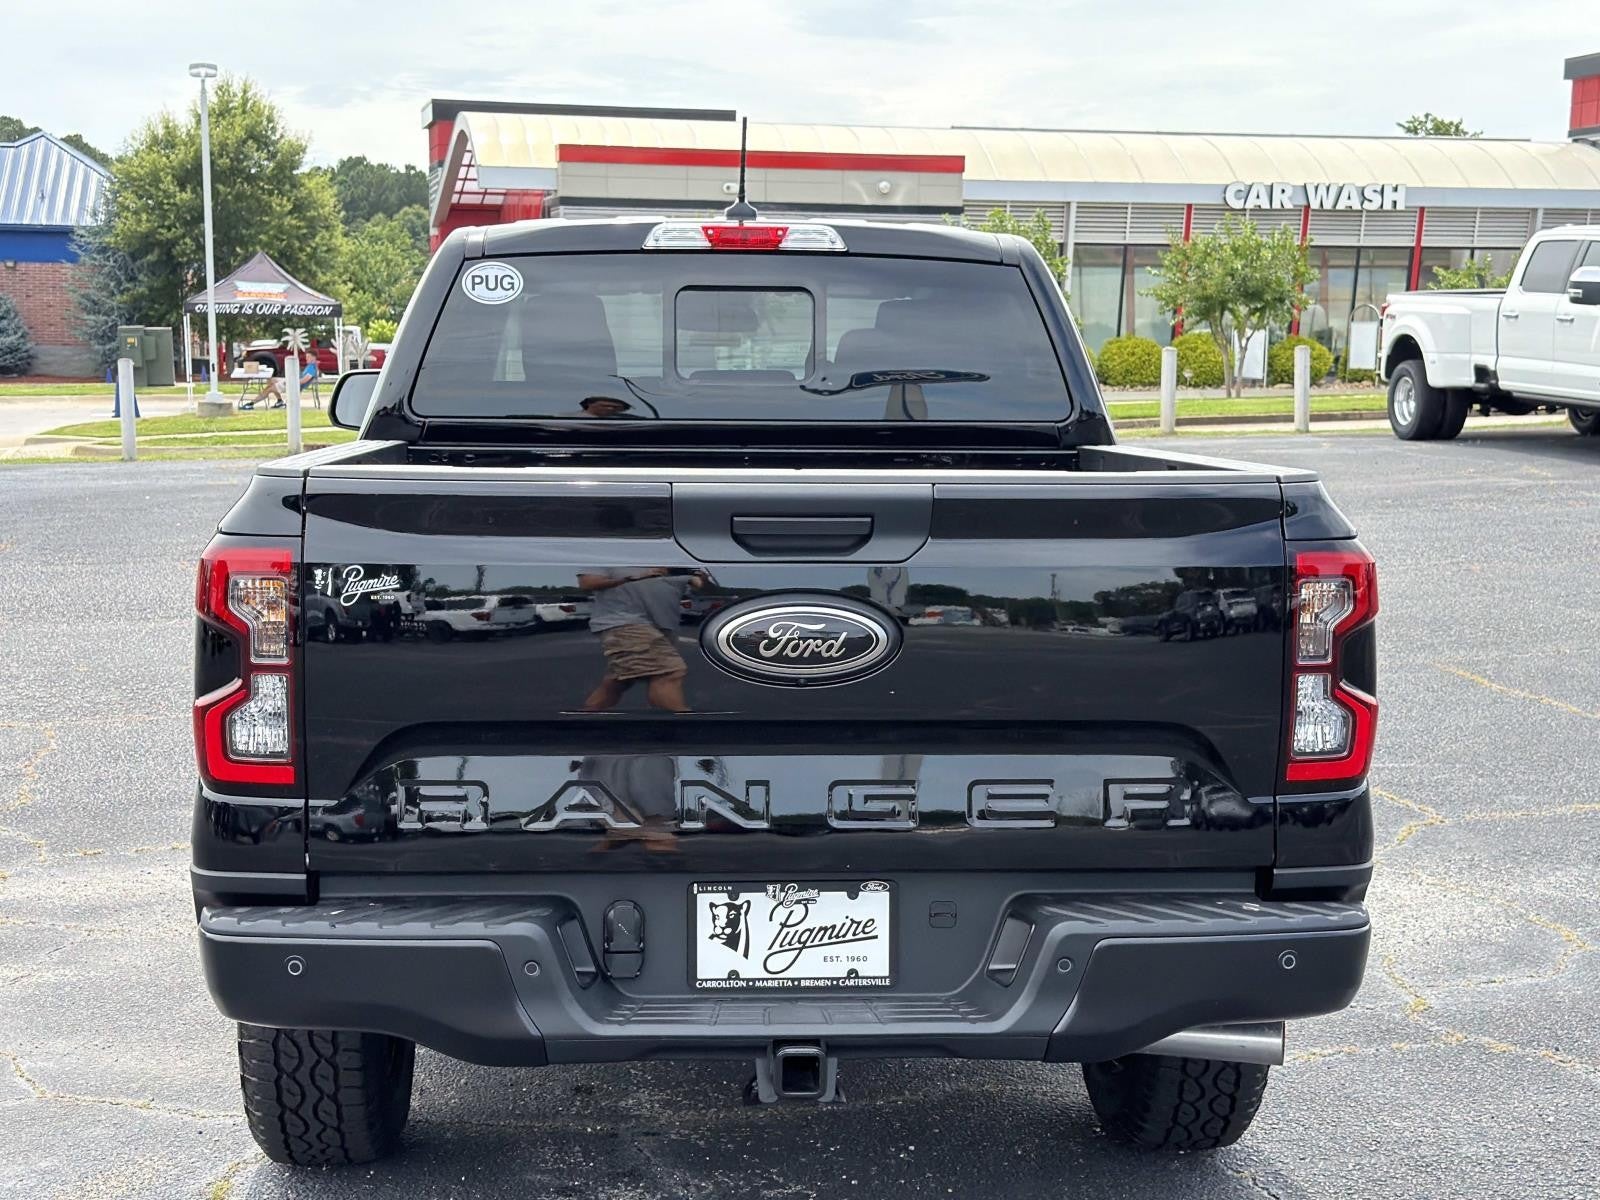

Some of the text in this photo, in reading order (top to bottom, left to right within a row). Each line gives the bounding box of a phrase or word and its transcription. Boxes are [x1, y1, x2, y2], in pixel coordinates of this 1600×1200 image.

[1224, 181, 1407, 210] CAR WASH
[471, 274, 515, 291] PUG
[241, 303, 254, 314] IS
[256, 302, 281, 314] OUR
[282, 304, 333, 315] PASSION
[340, 564, 400, 606] Pugmire
[758, 621, 848, 658] Ford
[397, 778, 1194, 830] RANGER
[763, 901, 879, 974] Pugmire
[823, 955, 869, 963] EST. 1960
[695, 978, 891, 988] CARROLLTON MARIETTA BREMEN CARTERSVILLE
